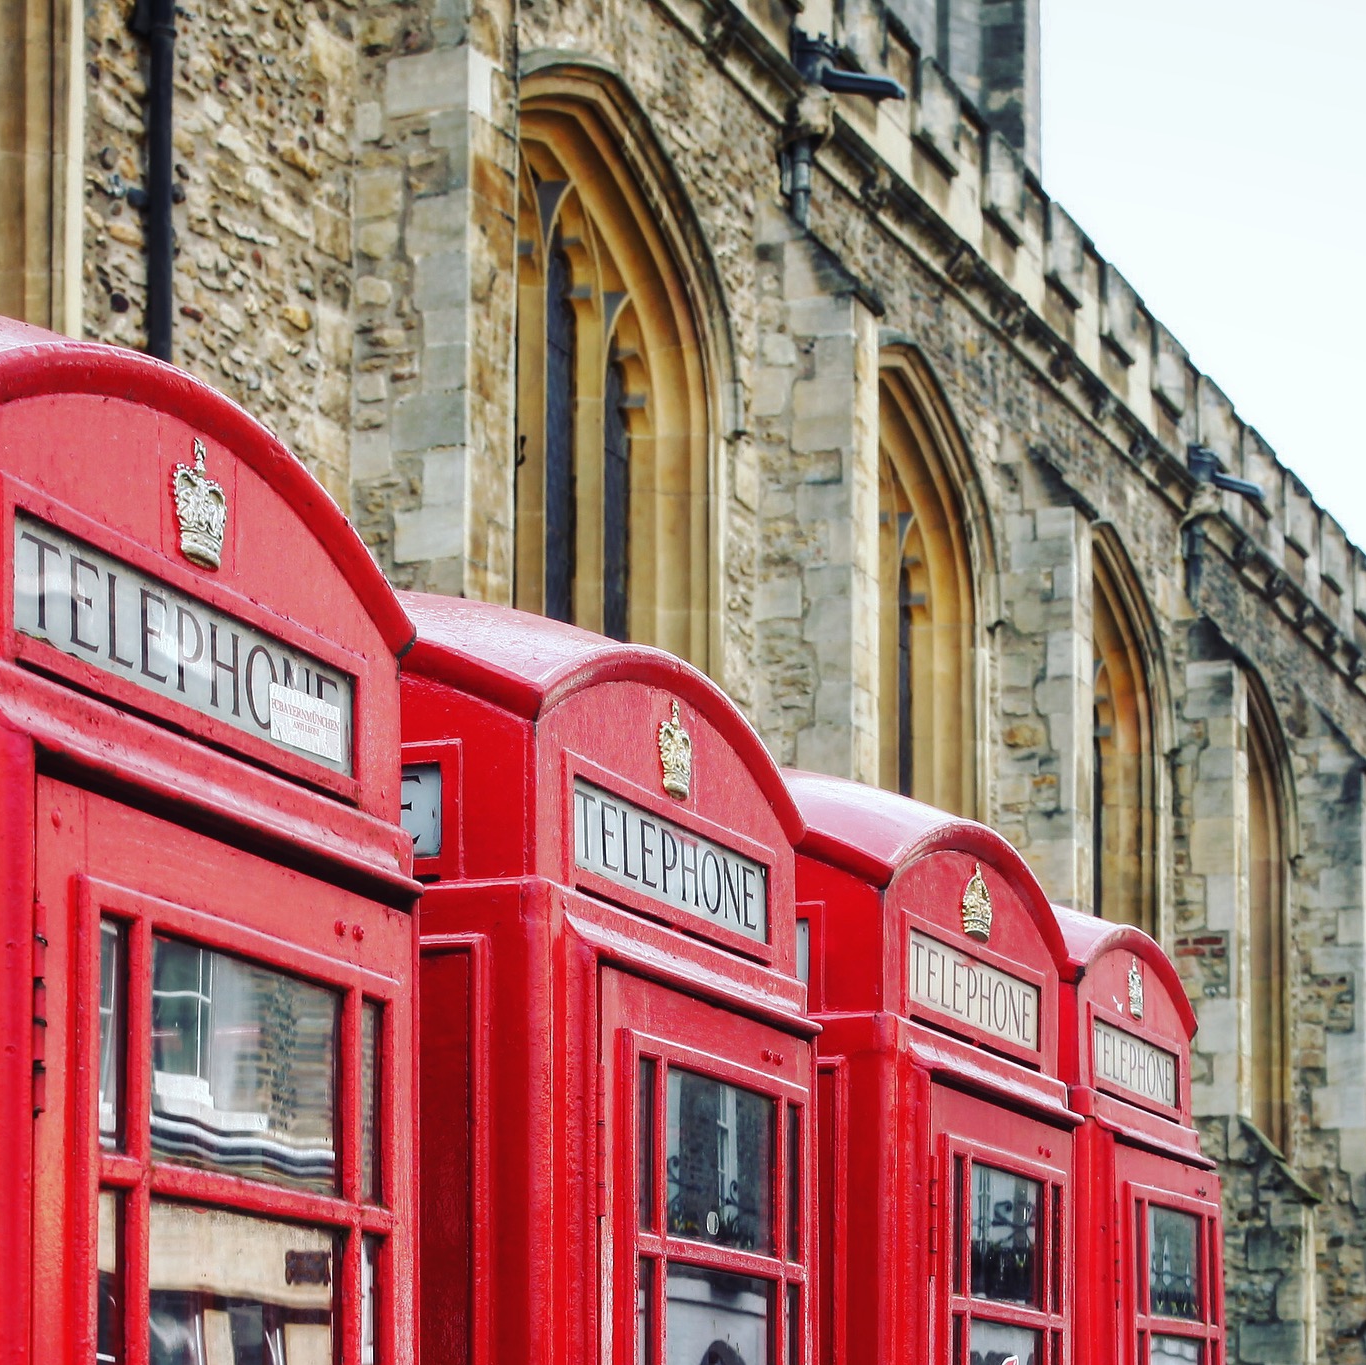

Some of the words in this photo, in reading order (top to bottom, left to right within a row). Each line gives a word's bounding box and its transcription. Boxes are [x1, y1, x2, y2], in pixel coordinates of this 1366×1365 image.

[575, 790, 760, 932] TELEPHONE
[911, 941, 1033, 1044] TELEPHONE
[1095, 1028, 1175, 1106] TELEPHONE
